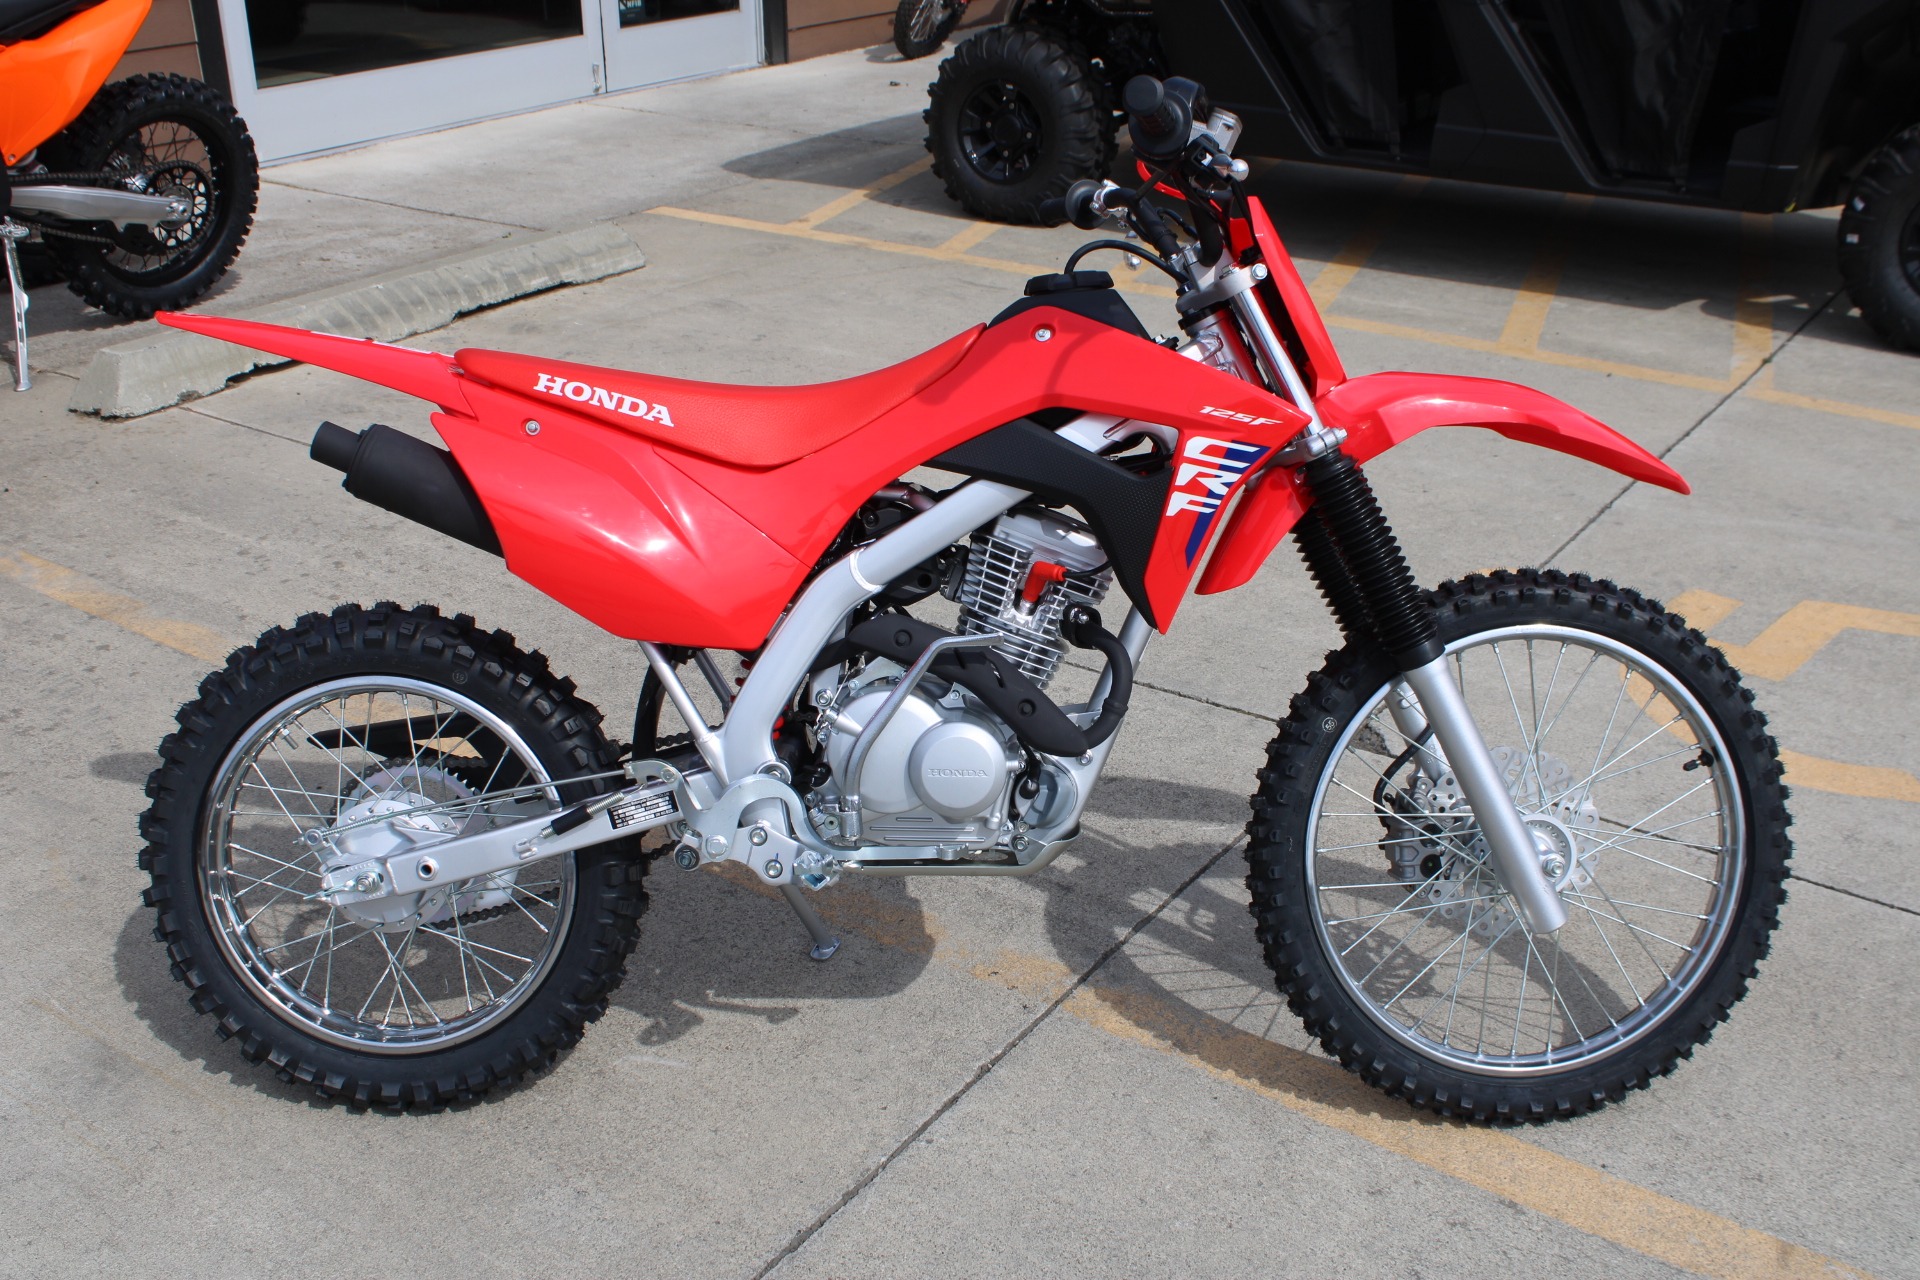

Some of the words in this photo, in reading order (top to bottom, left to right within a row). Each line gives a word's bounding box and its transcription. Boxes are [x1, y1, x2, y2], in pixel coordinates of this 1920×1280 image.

[533, 373, 675, 427] HONDA
[1200, 406, 1284, 426] 125F
[1165, 436, 1261, 517] CRF
[928, 768, 988, 778] HONDA
